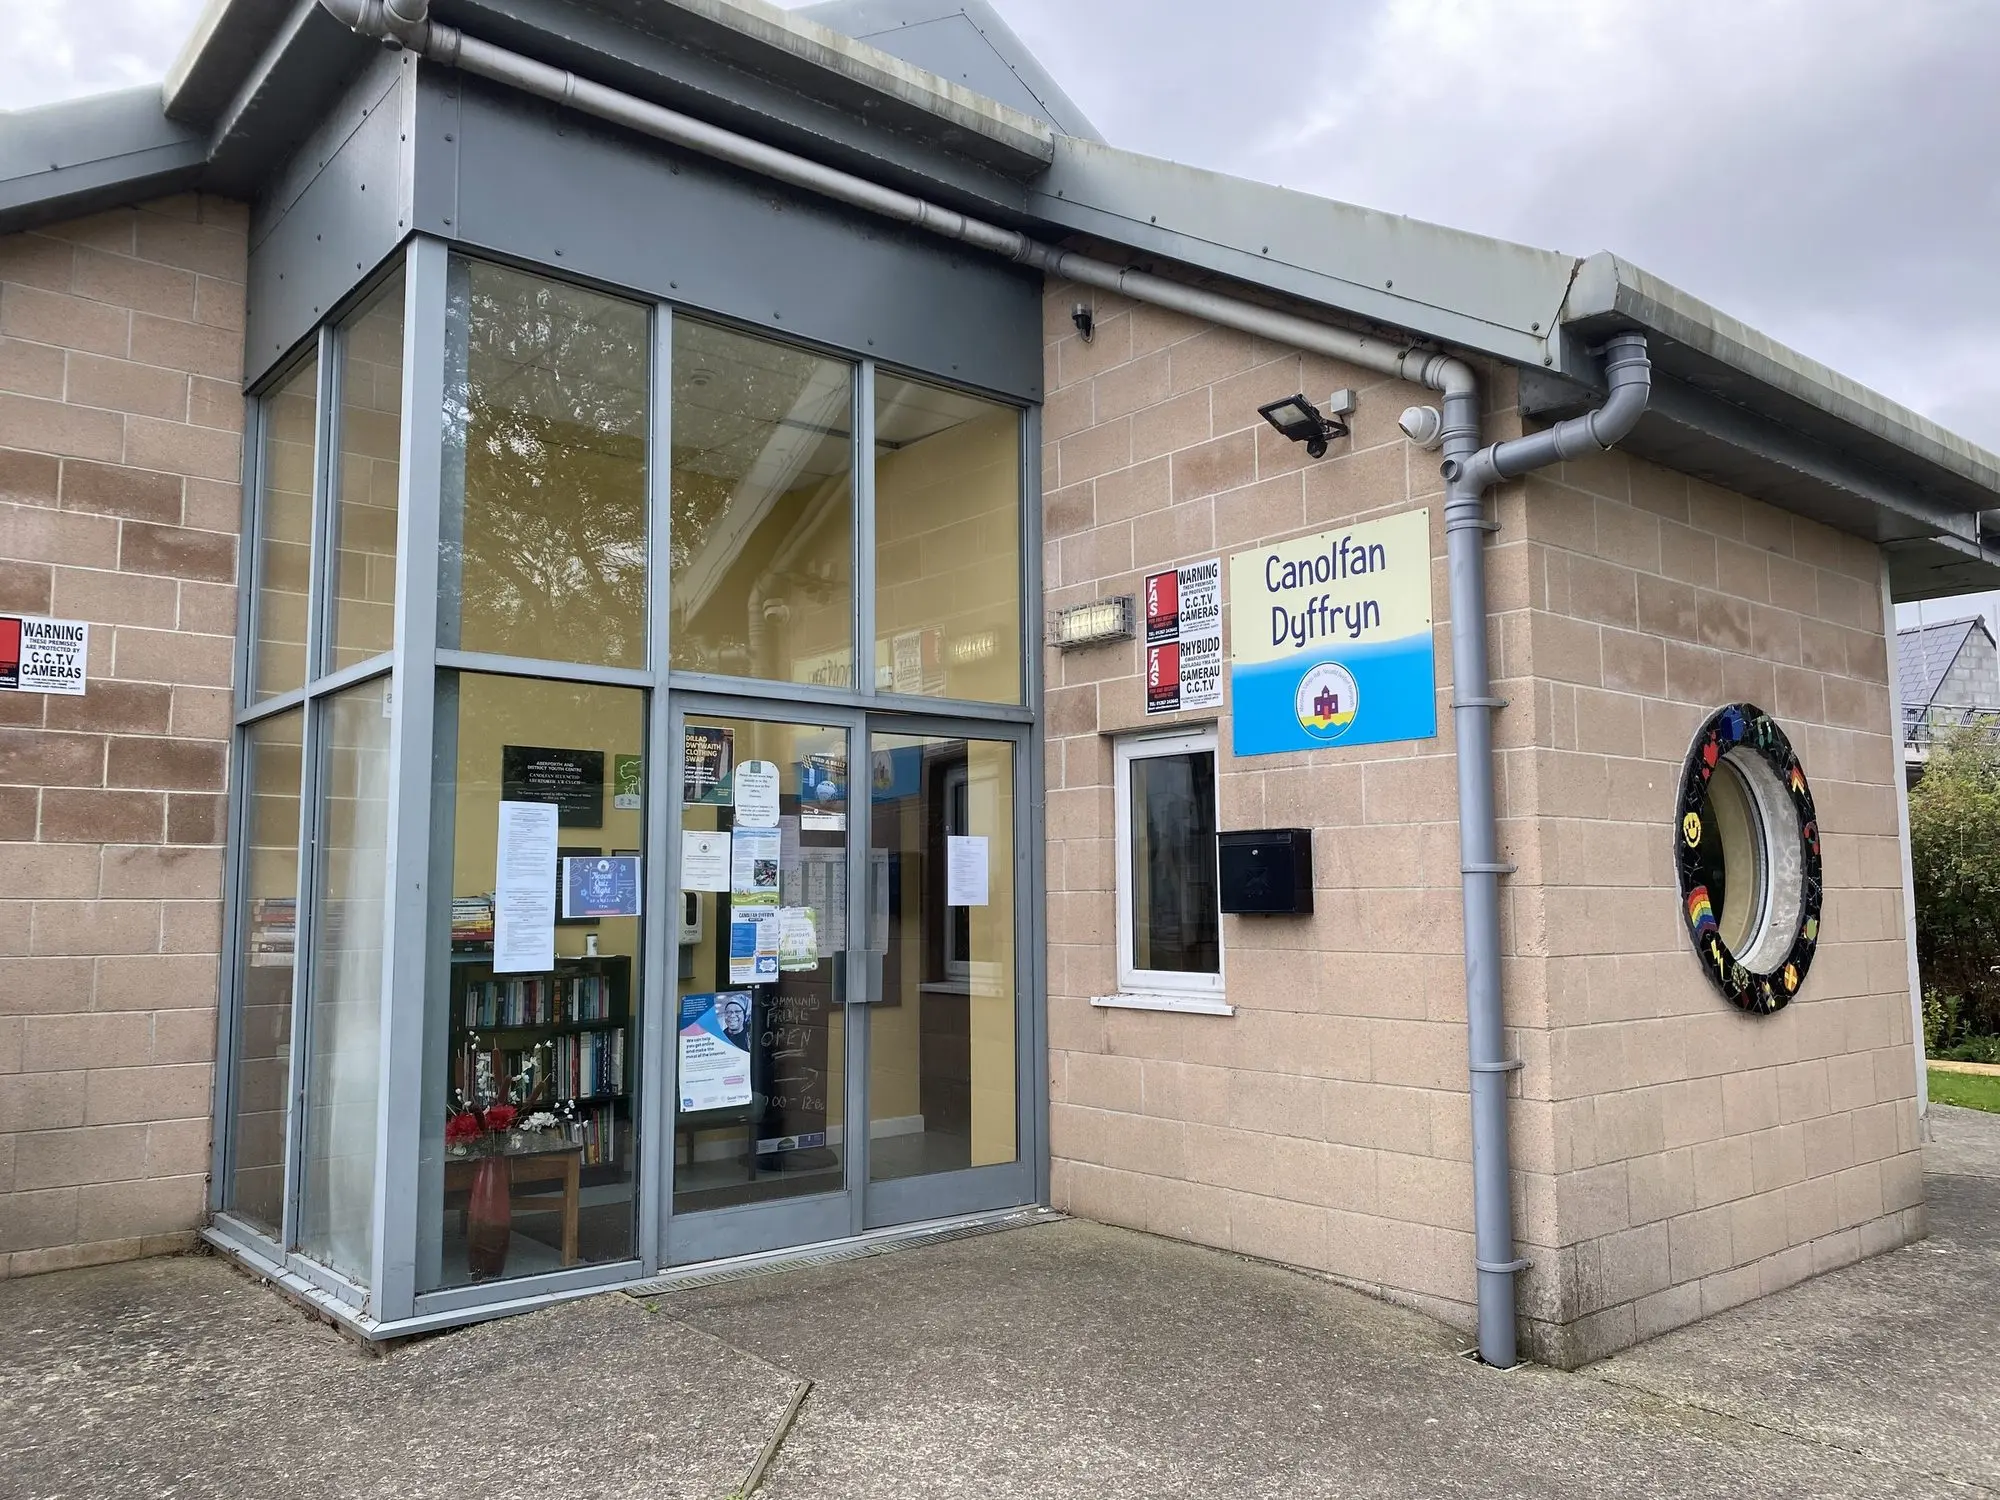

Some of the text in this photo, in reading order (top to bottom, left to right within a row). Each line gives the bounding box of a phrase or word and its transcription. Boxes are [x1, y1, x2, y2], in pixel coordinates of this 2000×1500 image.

[1265, 535, 1386, 593] Canolfan
[1179, 563, 1217, 585] WARNING
[1185, 593, 1213, 609] C.C.T.V
[1180, 604, 1219, 623] CAMERAS
[1272, 594, 1380, 648] Dyffryn
[23, 622, 83, 641] WARNING
[39, 645, 71, 653] PROTECTED
[48, 639, 77, 647] PREMISES
[1181, 636, 1220, 657] RHYBUDD
[31, 652, 74, 665] C.C.T.V
[22, 663, 82, 679] CAMERAS
[1181, 665, 1220, 682] GAMERAU
[1186, 678, 1214, 694] C.C.T.V
[761, 1028, 812, 1047] OPEN
